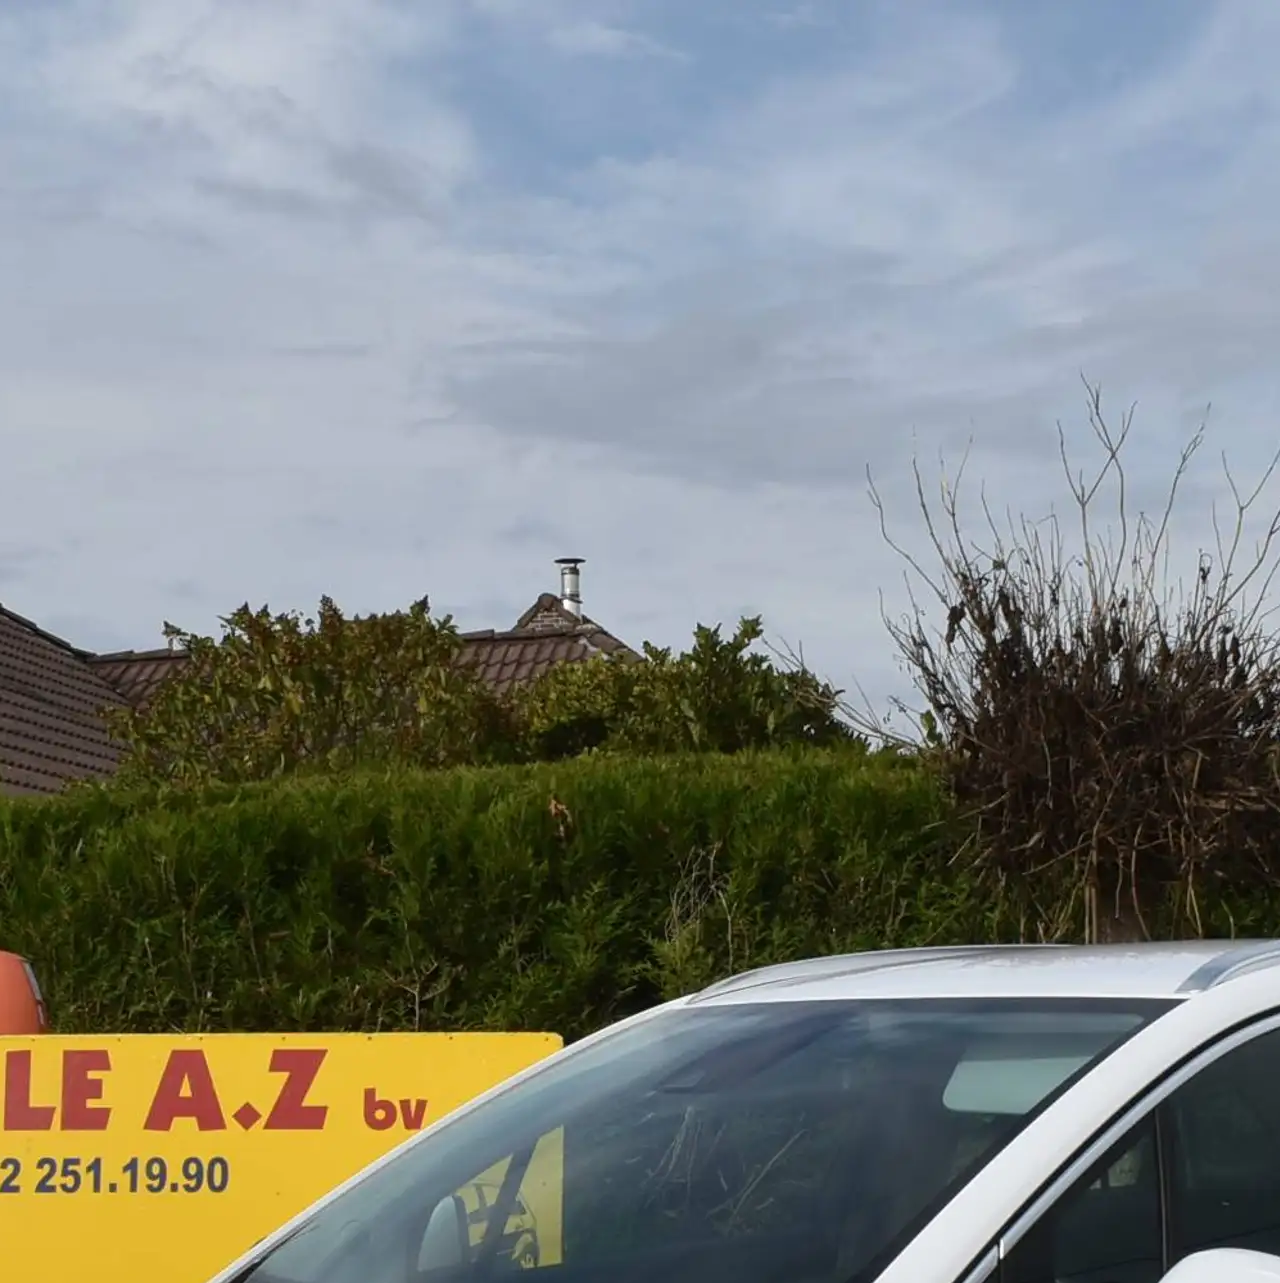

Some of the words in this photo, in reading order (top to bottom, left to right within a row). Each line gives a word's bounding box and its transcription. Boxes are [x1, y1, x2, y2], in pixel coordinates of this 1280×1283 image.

[143, 1048, 329, 1132] A.Z
[363, 1087, 428, 1131] bv
[34, 1156, 229, 1194] 251.19.90
